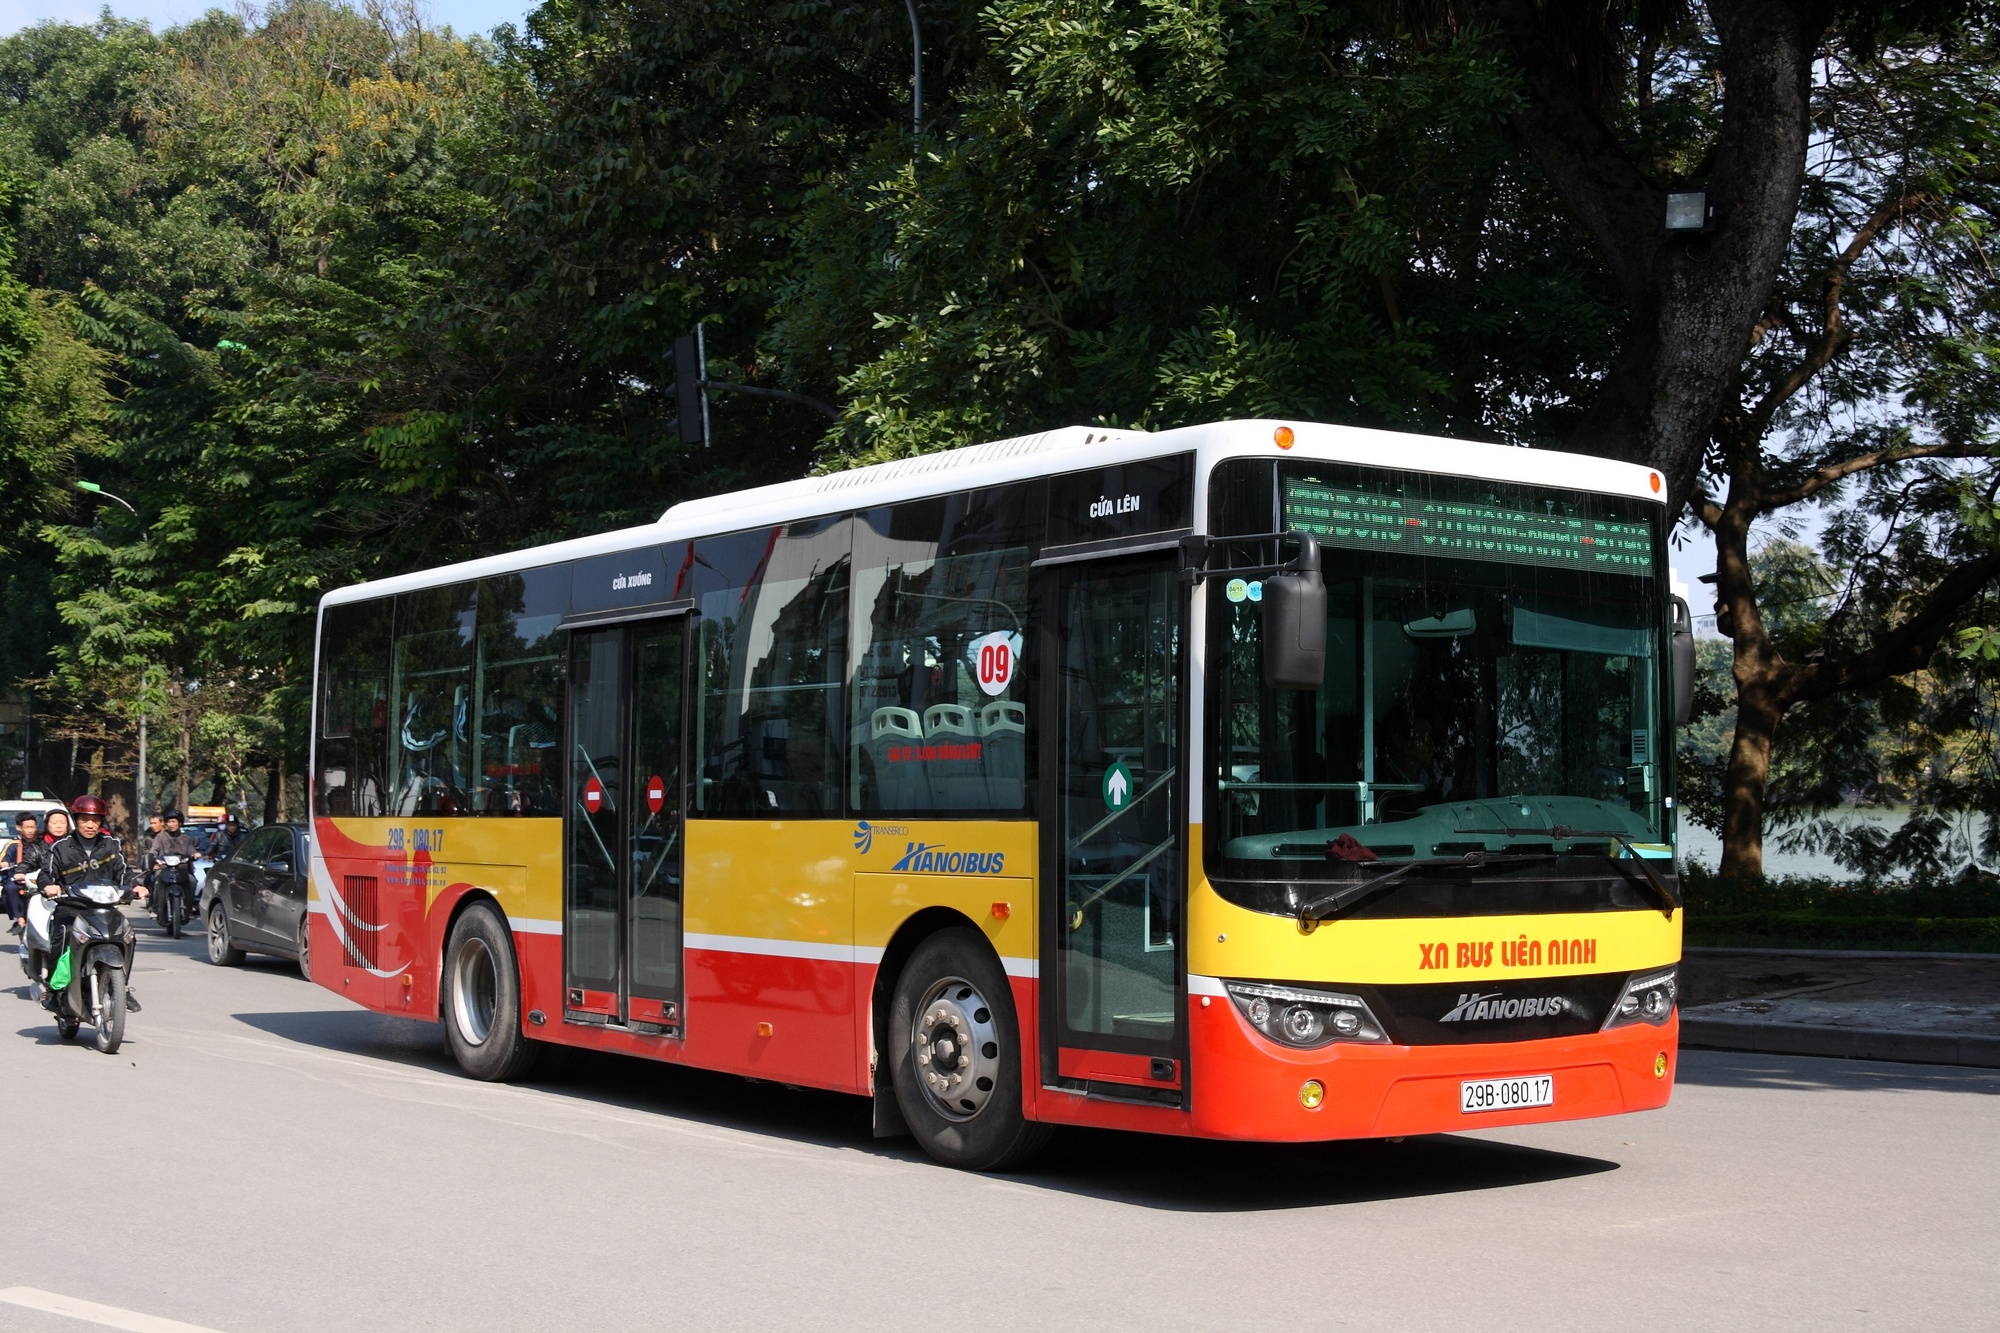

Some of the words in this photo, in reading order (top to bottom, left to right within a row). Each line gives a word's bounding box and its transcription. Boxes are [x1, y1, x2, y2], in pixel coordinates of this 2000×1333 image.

[1090, 495, 1113, 518] CỬA
[1117, 494, 1140, 514] LÊN
[612, 573, 626, 590] CỬA
[627, 570, 652, 588] XUỐNG
[981, 644, 1009, 684] 09
[388, 828, 404, 850] 29B
[413, 828, 444, 852] 080.17
[872, 825, 909, 836] TRANSERCO
[891, 842, 1004, 874] HANOIBUS
[1419, 942, 1448, 969] XN
[1456, 941, 1493, 968] BUS
[1501, 934, 1541, 967] LIÊN
[1548, 939, 1597, 965] NINH
[1439, 992, 1563, 1023] HANOIBUS
